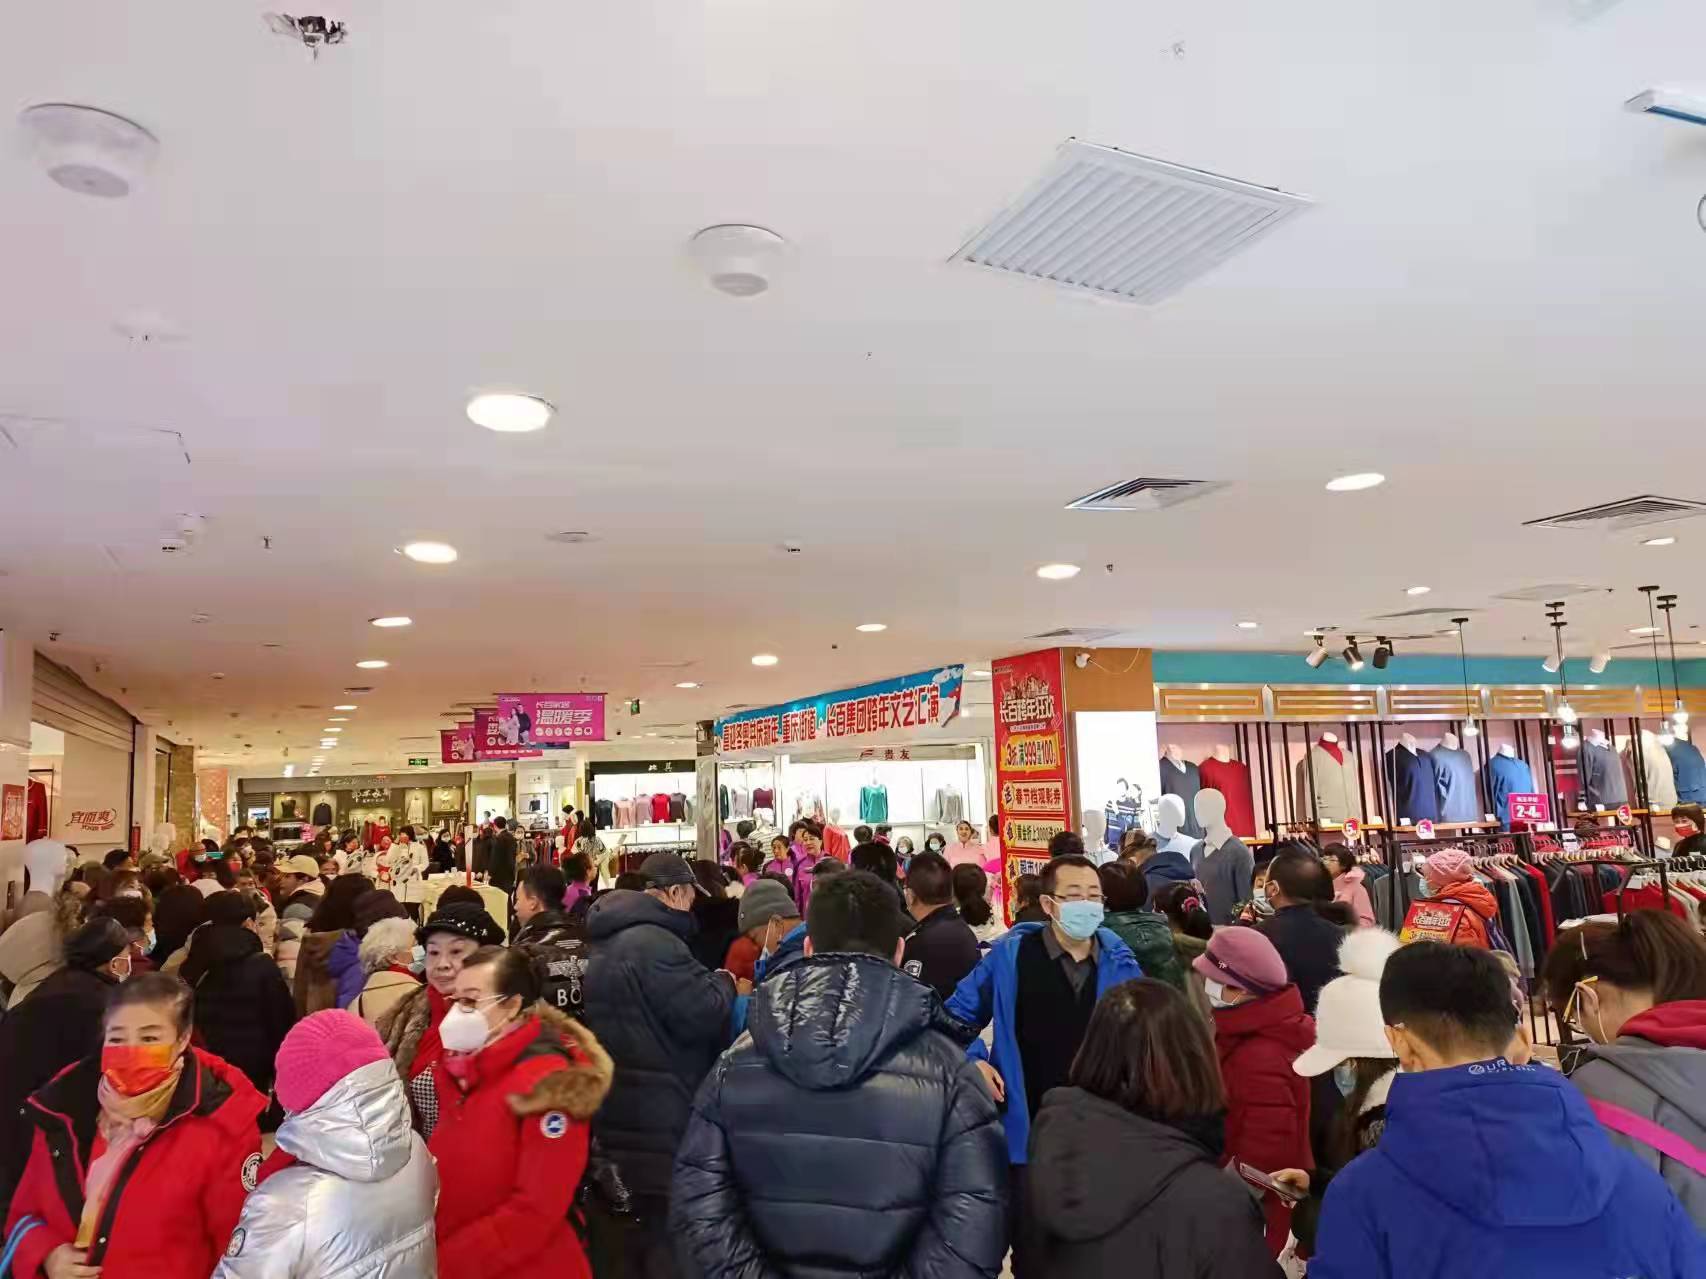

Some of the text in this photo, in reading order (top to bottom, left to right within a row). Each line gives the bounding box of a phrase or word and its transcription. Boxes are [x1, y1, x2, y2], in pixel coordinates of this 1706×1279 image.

[535, 709, 593, 725] 温暖季
[70, 810, 111, 824] 宜而爽
